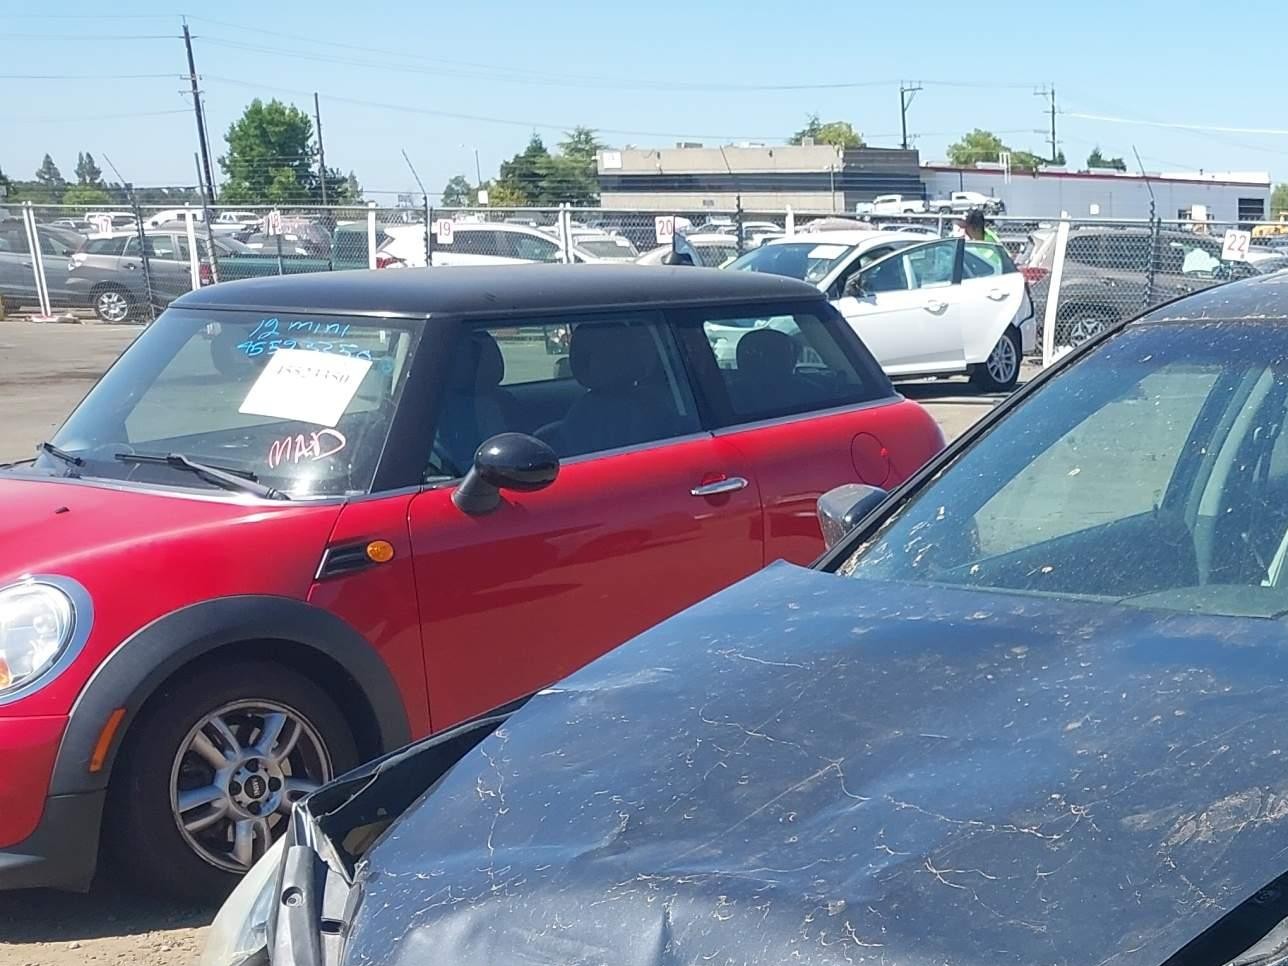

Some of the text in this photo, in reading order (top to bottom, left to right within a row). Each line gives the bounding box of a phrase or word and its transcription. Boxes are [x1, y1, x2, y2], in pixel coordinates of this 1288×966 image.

[439, 221, 451, 236] 19
[658, 219, 673, 236] 20
[1226, 233, 1248, 252] 22
[269, 428, 346, 469] MAD
